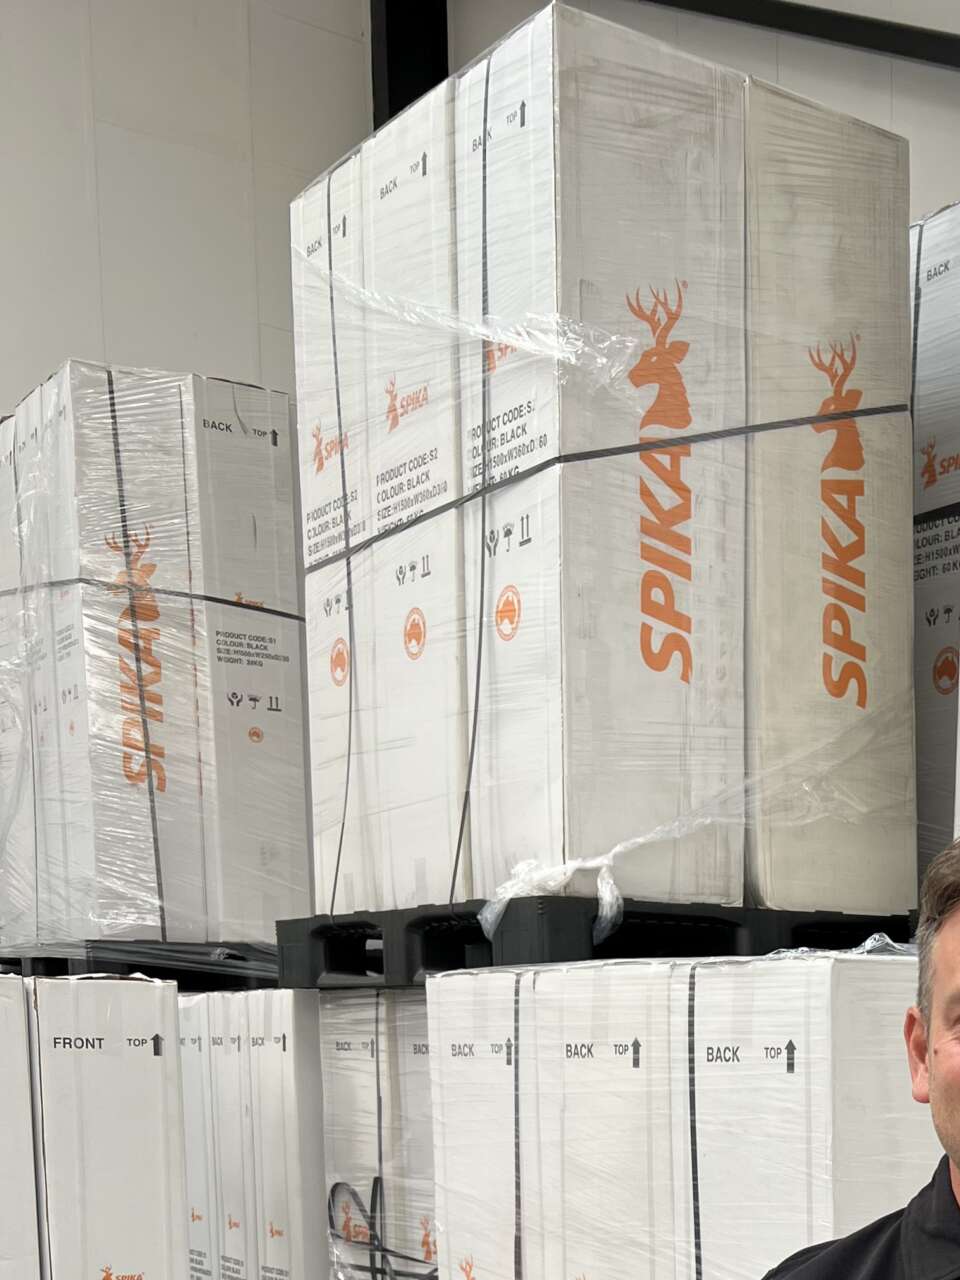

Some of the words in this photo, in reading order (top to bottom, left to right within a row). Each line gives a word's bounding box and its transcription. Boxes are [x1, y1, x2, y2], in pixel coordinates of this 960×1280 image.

[472, 126, 492, 152] BAK
[380, 175, 399, 200] BACK
[927, 260, 950, 281] BACK
[400, 384, 429, 418] SPIKA
[502, 400, 535, 427] CODE:S
[202, 419, 233, 433] BACK
[252, 428, 268, 438] TOP
[500, 422, 528, 447] BLACK
[376, 462, 407, 487] PRODUCT
[377, 481, 406, 504] COLOUR:
[406, 469, 431, 491] BLACK
[331, 510, 352, 529] BLAK
[639, 435, 694, 685] SPIKA
[820, 479, 868, 710] SPIKA
[118, 627, 166, 793] SPIKA
[53, 1037, 104, 1050] FRONT
[127, 1038, 148, 1048] TOP
[451, 1043, 475, 1057] BACK
[490, 1043, 503, 1055] TOP
[566, 1043, 594, 1058] BACK
[614, 1044, 629, 1056] TOP
[706, 1046, 740, 1062] BACK
[764, 1047, 782, 1059] TOP
